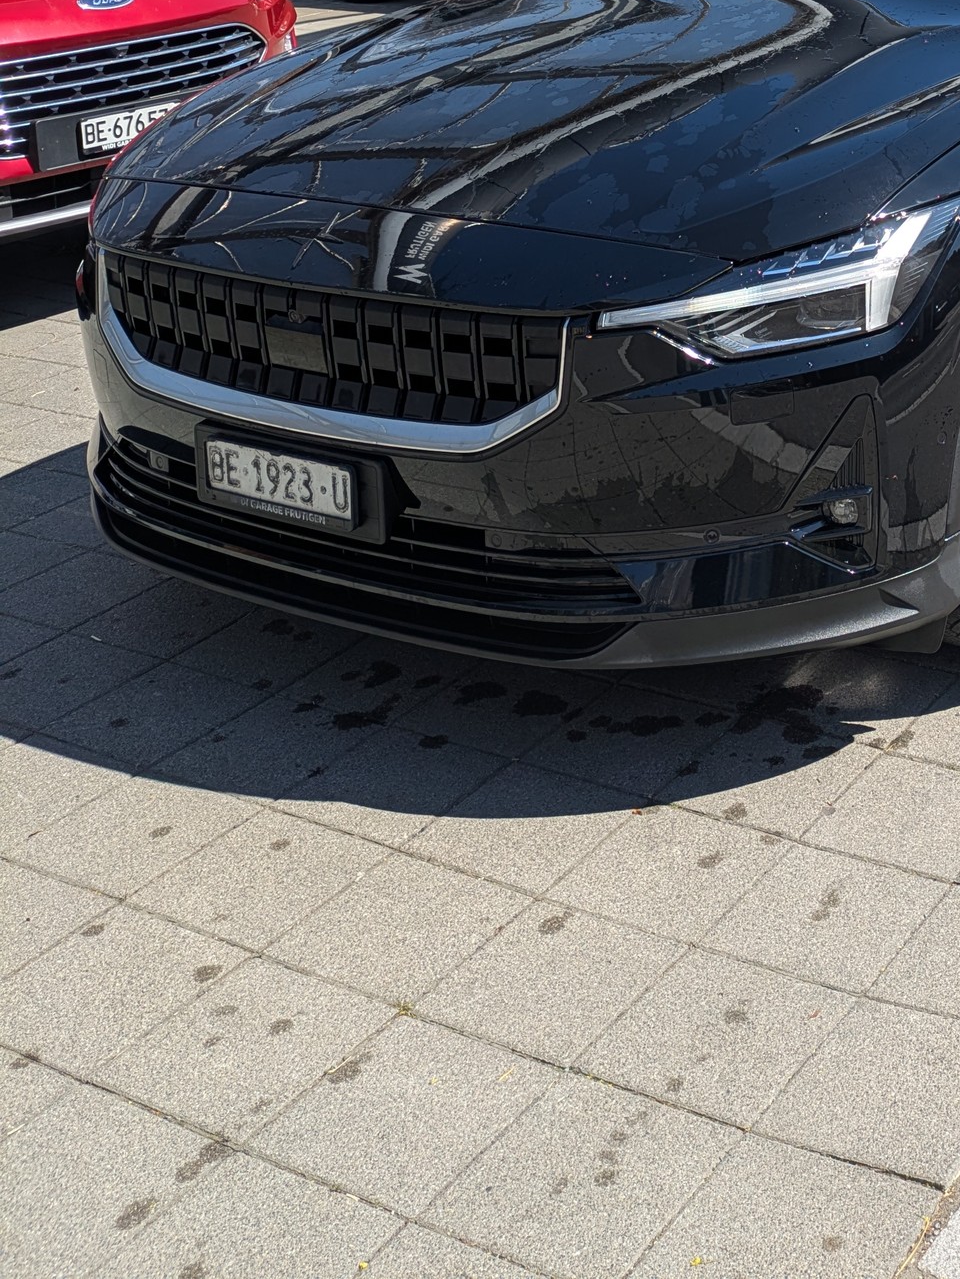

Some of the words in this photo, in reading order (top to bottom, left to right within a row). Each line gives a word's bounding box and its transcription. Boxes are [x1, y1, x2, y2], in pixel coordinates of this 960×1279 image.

[101, 142, 117, 151] WIDI
[250, 498, 284, 516] GARAGE
[284, 506, 326, 526] FRUTIGEN
